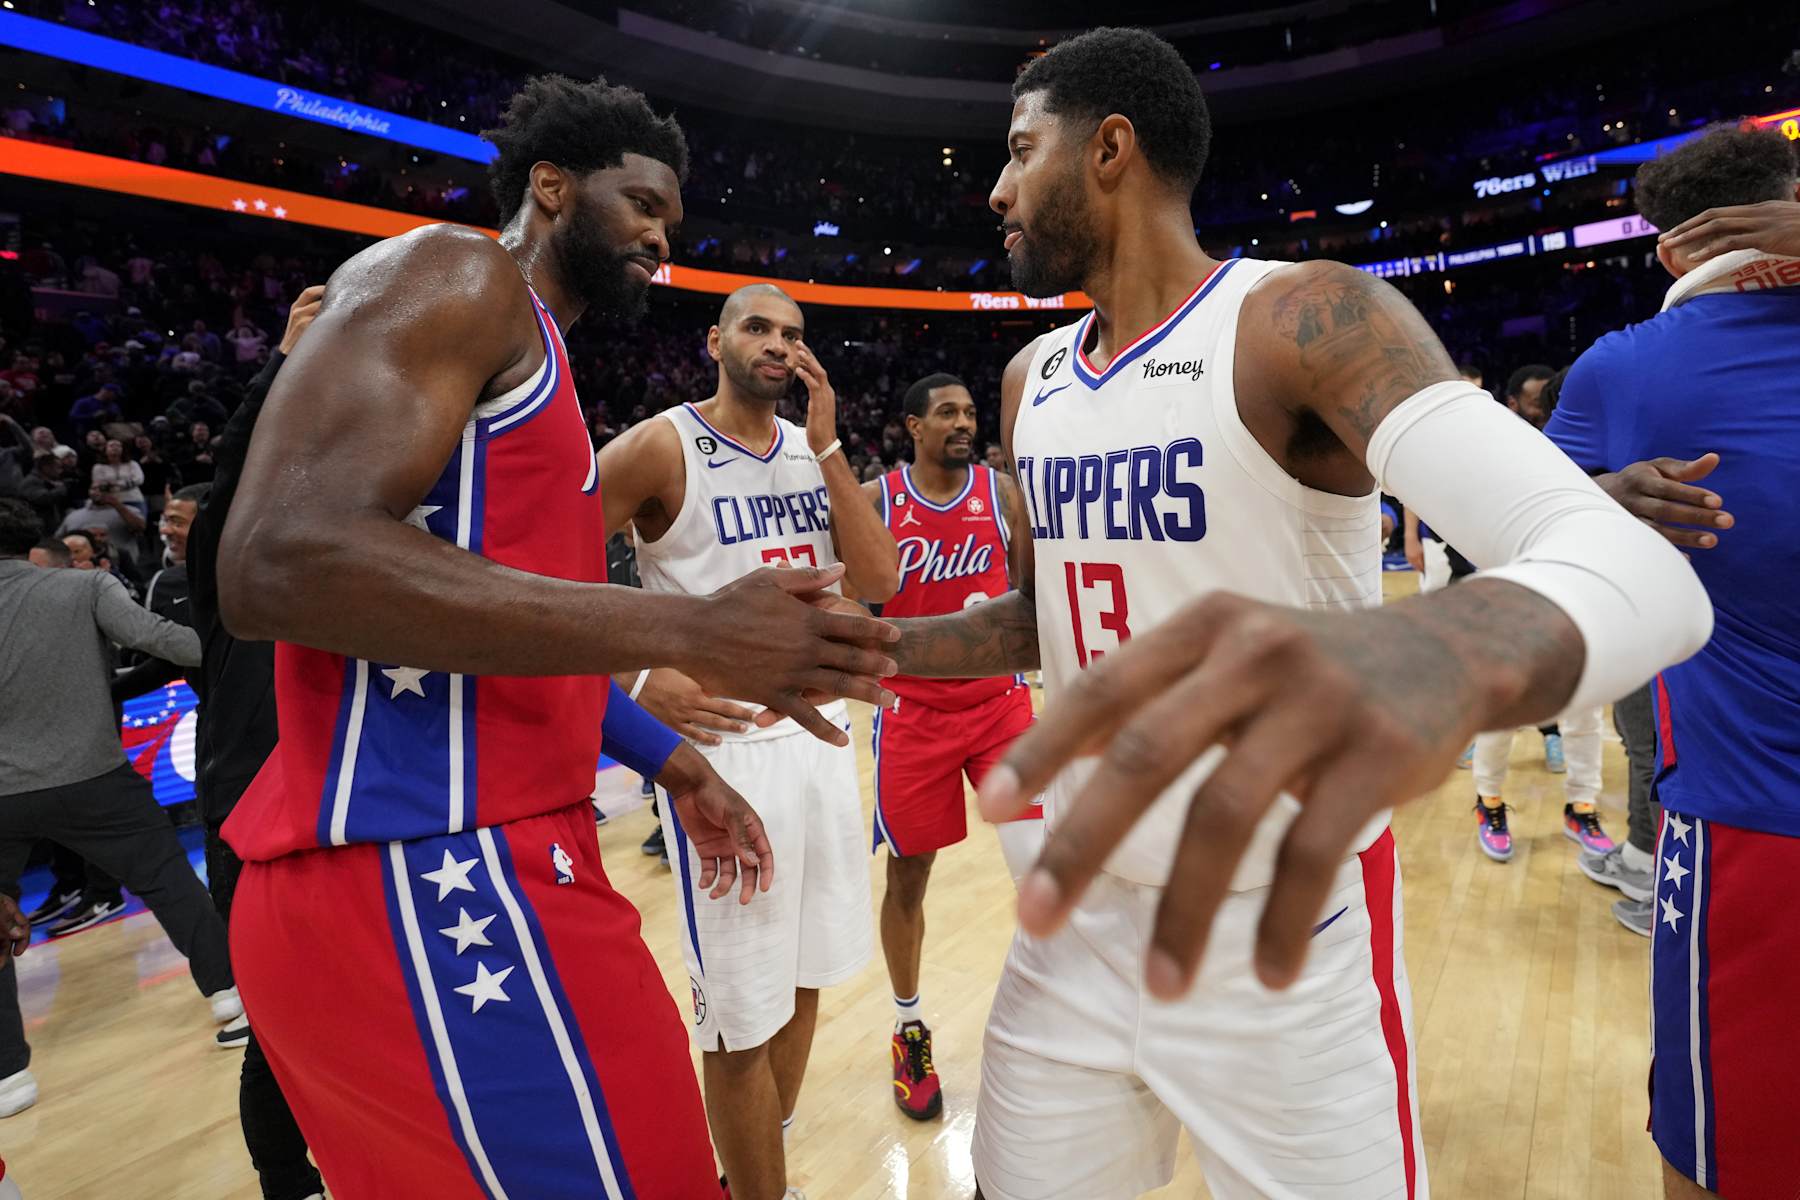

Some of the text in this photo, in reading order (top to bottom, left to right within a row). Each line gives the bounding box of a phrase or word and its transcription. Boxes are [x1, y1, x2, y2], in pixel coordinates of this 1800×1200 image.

[274, 87, 391, 133] Philadelphia
[1473, 155, 1597, 198] 76ers Win!
[970, 293, 1019, 310] 76ers
[1143, 358, 1204, 381] honey
[711, 485, 830, 546] CLIPPERS
[897, 533, 993, 593] Phila
[1064, 562, 1132, 671] 13
